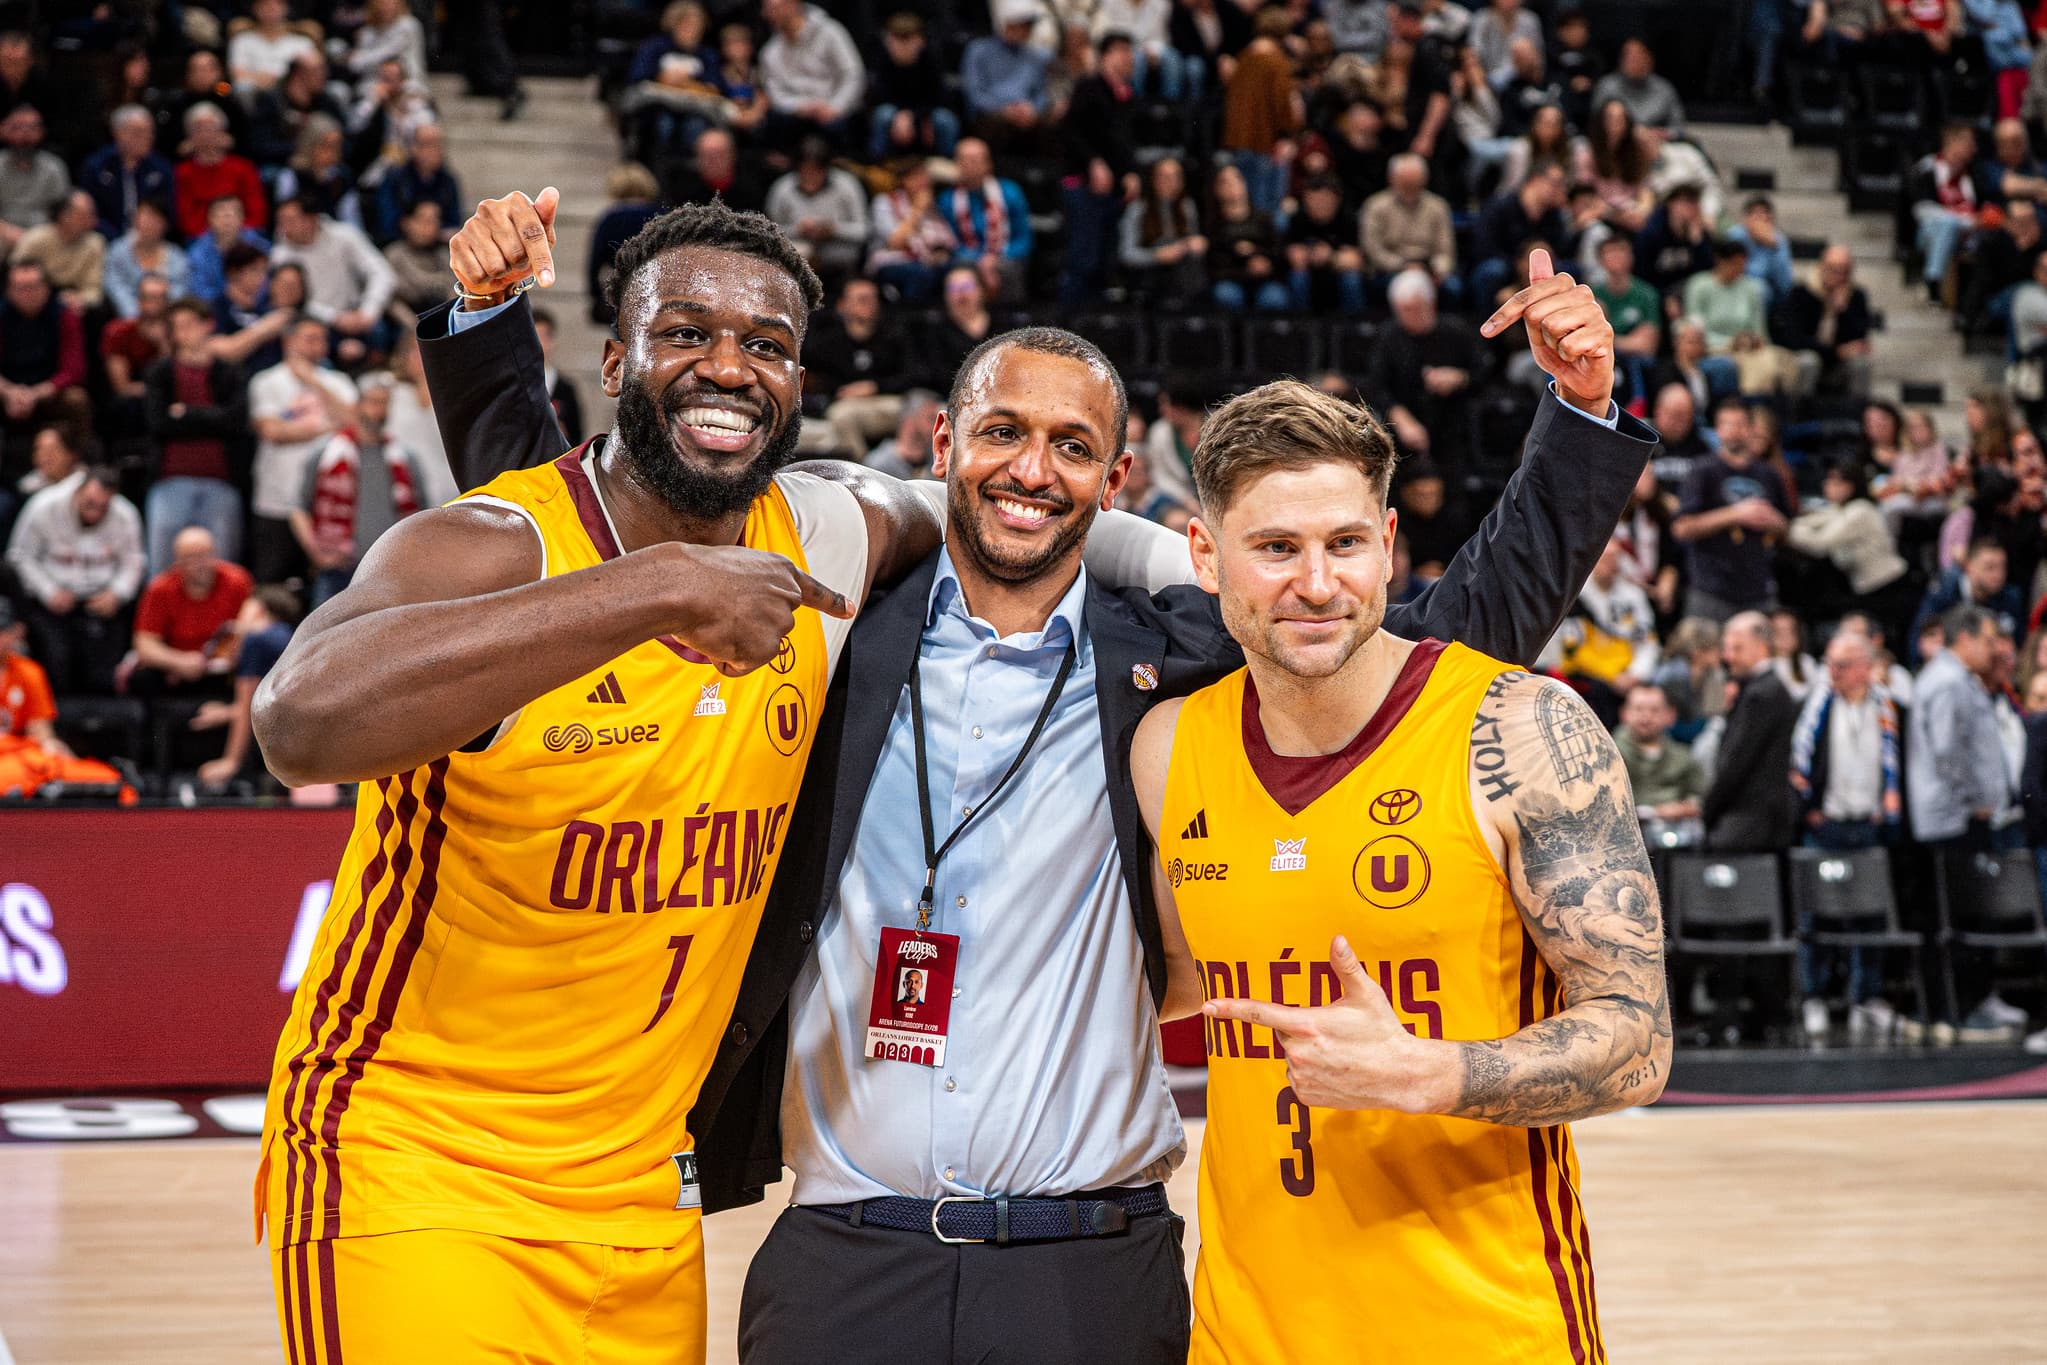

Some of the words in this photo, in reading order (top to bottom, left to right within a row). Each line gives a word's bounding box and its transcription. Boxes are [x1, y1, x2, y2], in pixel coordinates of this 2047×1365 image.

[596, 723, 660, 746] suez
[776, 702, 799, 741] U
[1184, 862, 1229, 881] suez
[1371, 854, 1409, 893] U
[0, 882, 68, 996] S
[897, 940, 938, 960] LEADERS
[888, 1045, 896, 1057] 2
[901, 1046, 908, 1058] 3
[1276, 1085, 1315, 1198] 3
